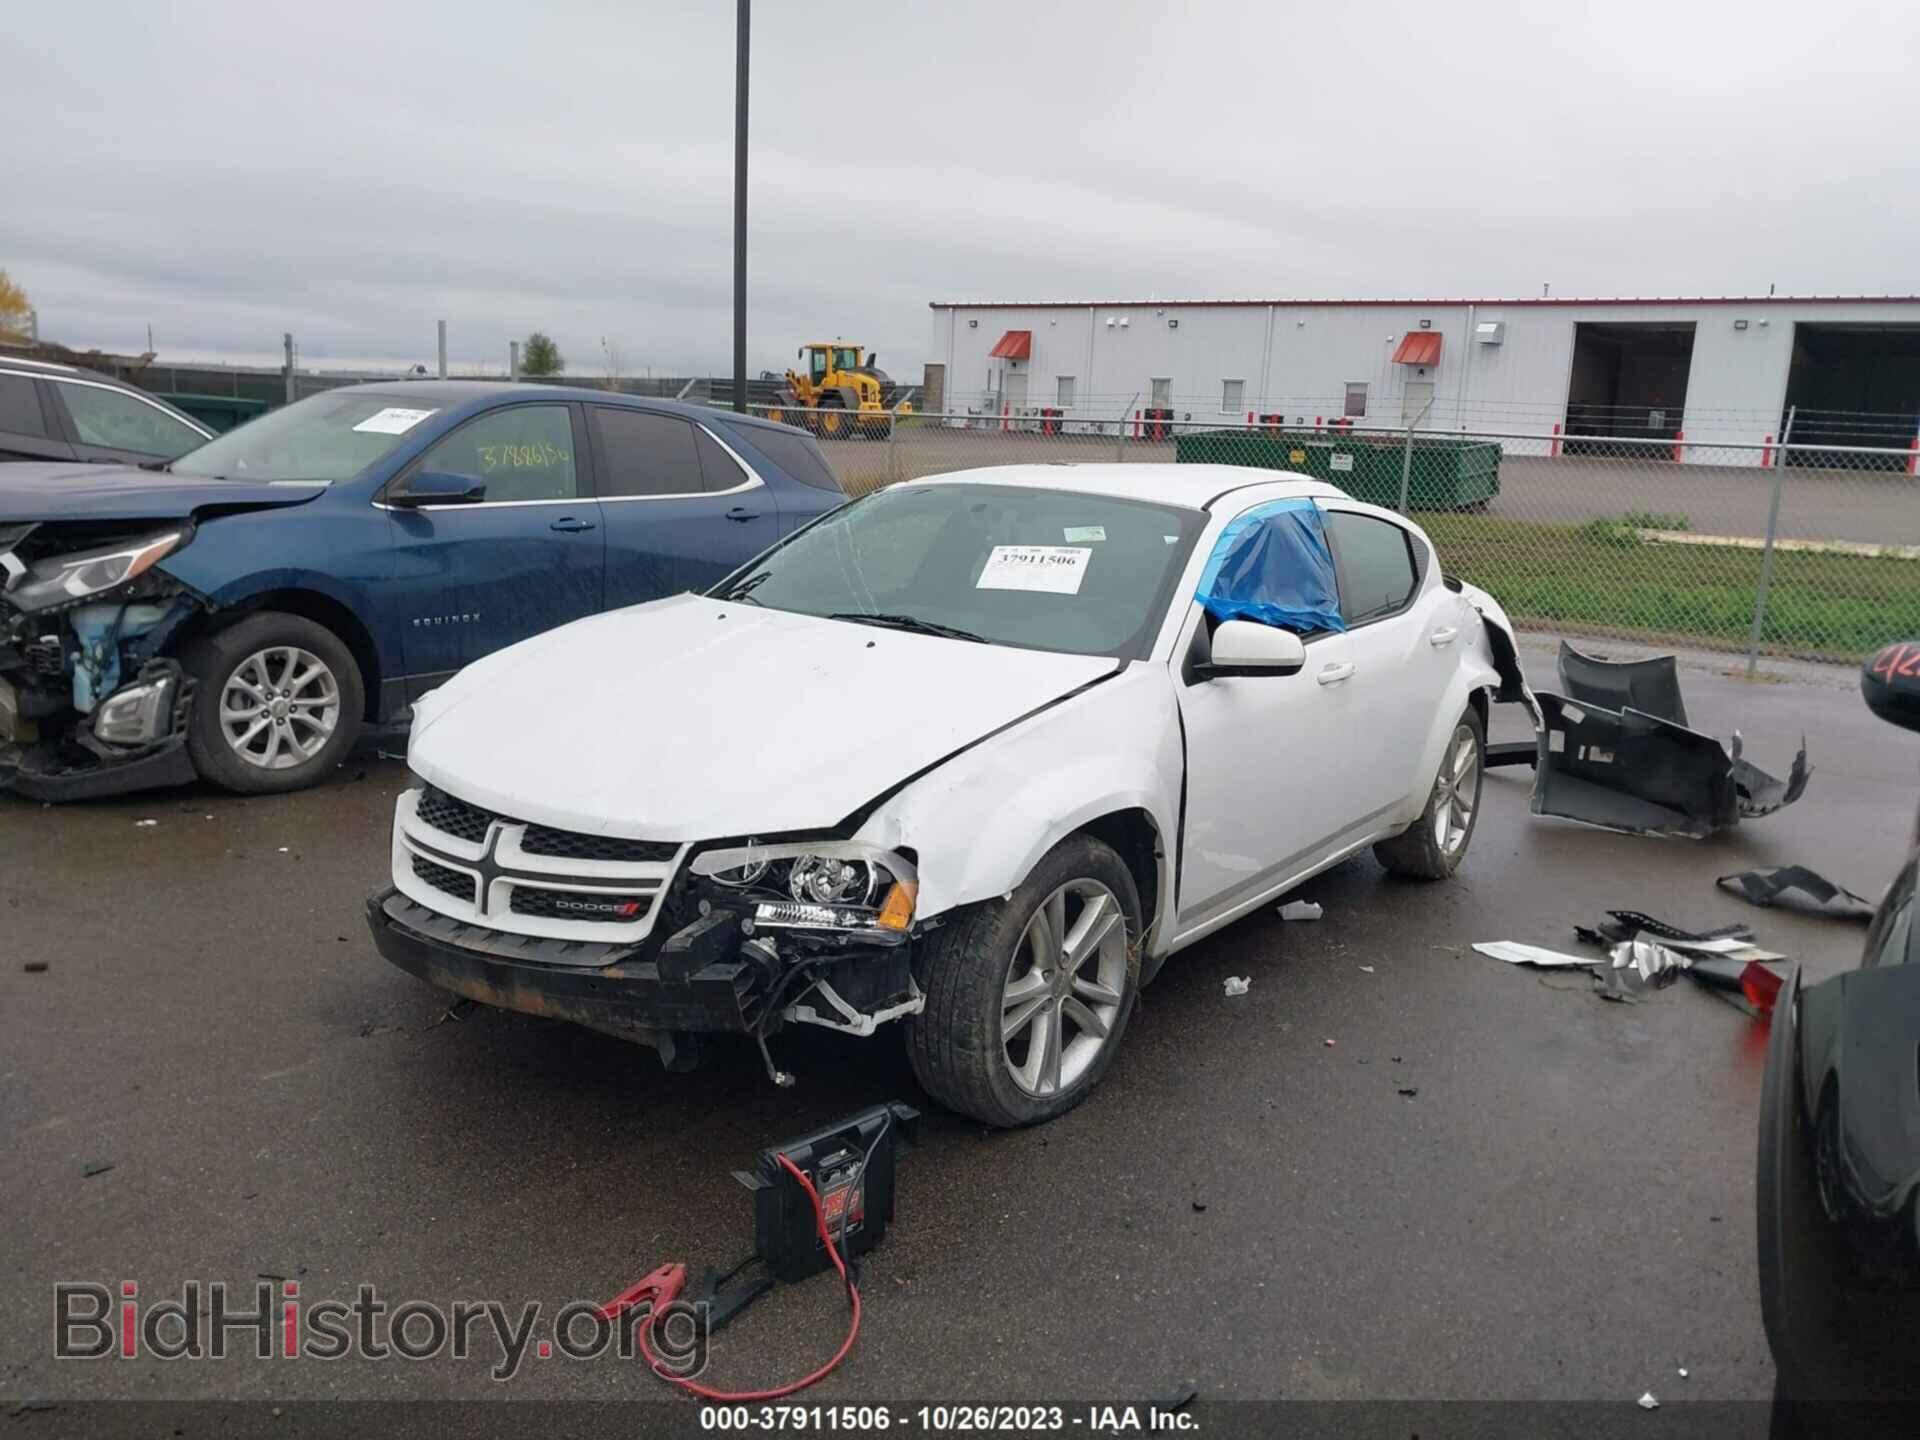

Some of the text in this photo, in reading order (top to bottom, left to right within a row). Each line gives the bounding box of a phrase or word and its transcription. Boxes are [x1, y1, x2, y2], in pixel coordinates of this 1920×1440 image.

[1000, 554, 1077, 566] 37911506
[413, 613, 480, 627] EQUINOX
[556, 900, 626, 914] DODGE
